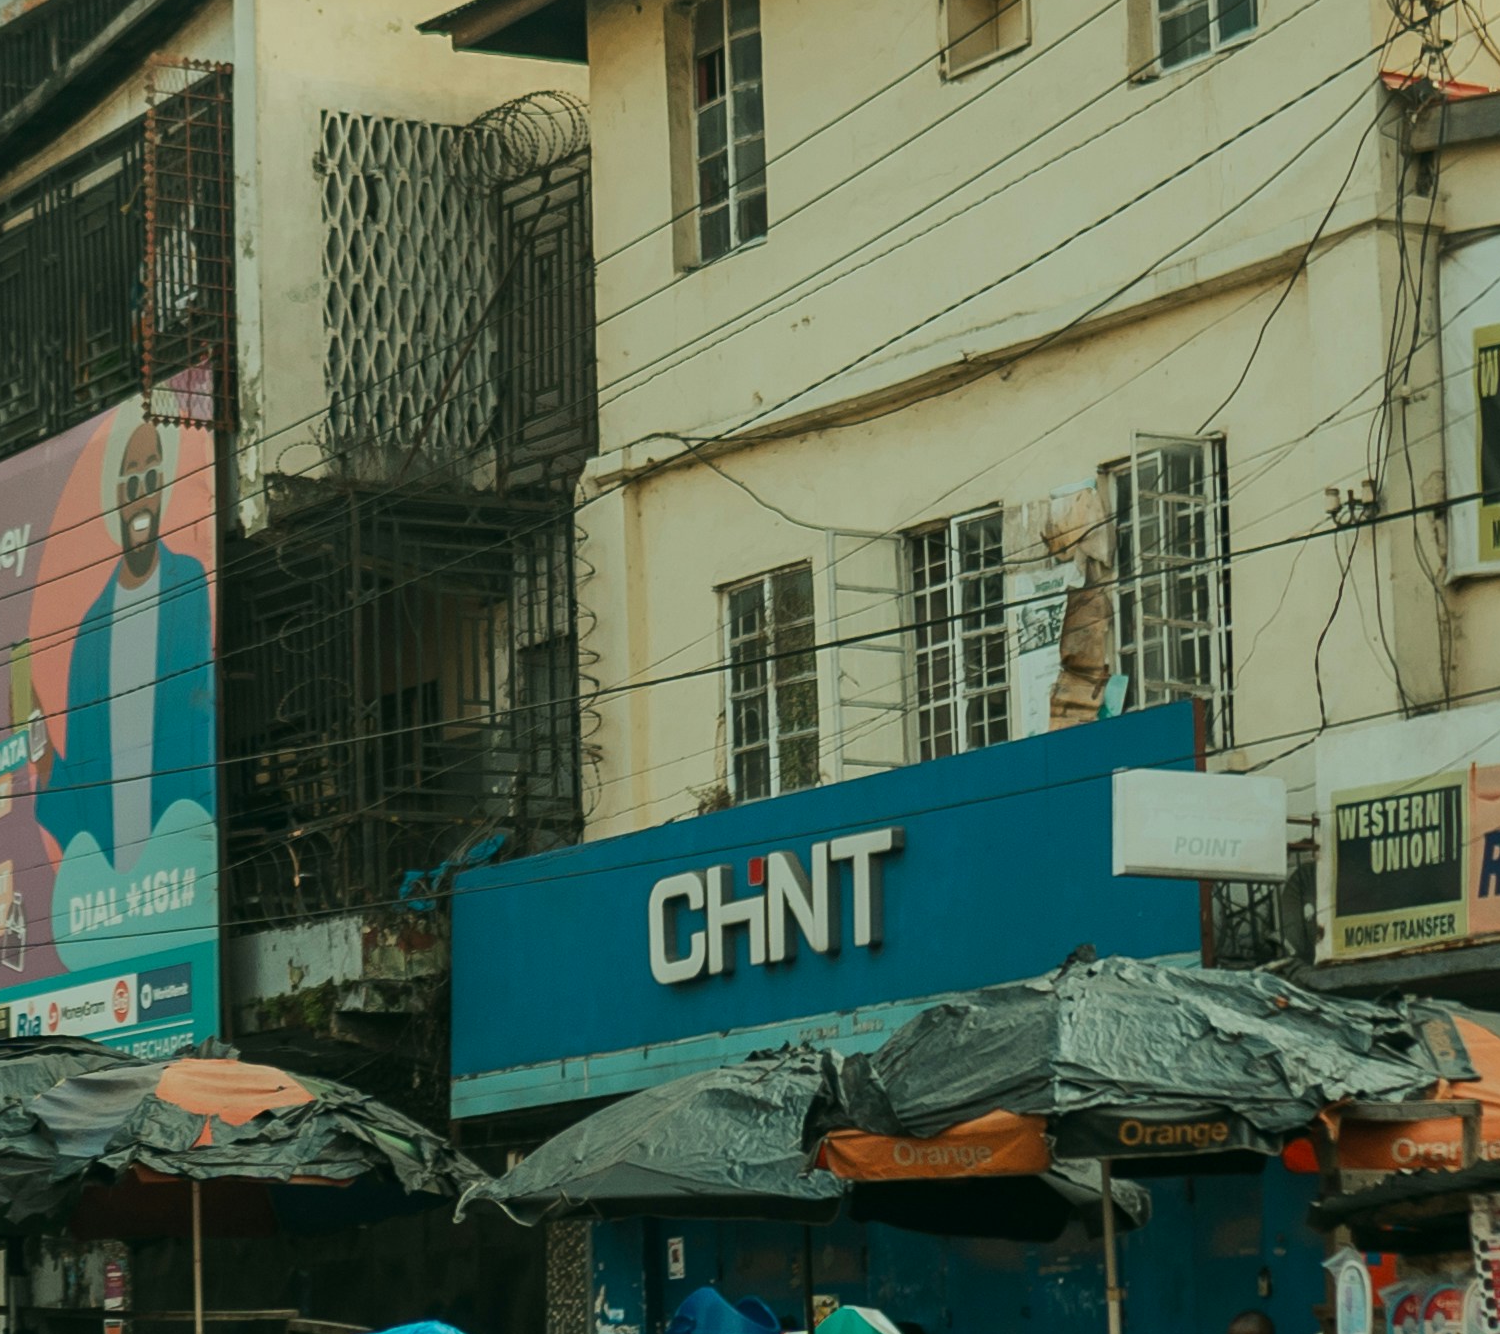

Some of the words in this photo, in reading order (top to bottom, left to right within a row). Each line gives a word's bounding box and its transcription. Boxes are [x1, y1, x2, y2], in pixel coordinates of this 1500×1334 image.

[1337, 793, 1440, 841] WESTERN
[1174, 835, 1242, 857] POINT
[1369, 828, 1441, 877] UNION
[69, 887, 124, 935] DIAL
[1344, 922, 1389, 949] MONEY
[1392, 913, 1456, 942] TRANSFER
[1118, 1120, 1230, 1147] Orange
[893, 1140, 993, 1168] Orange
